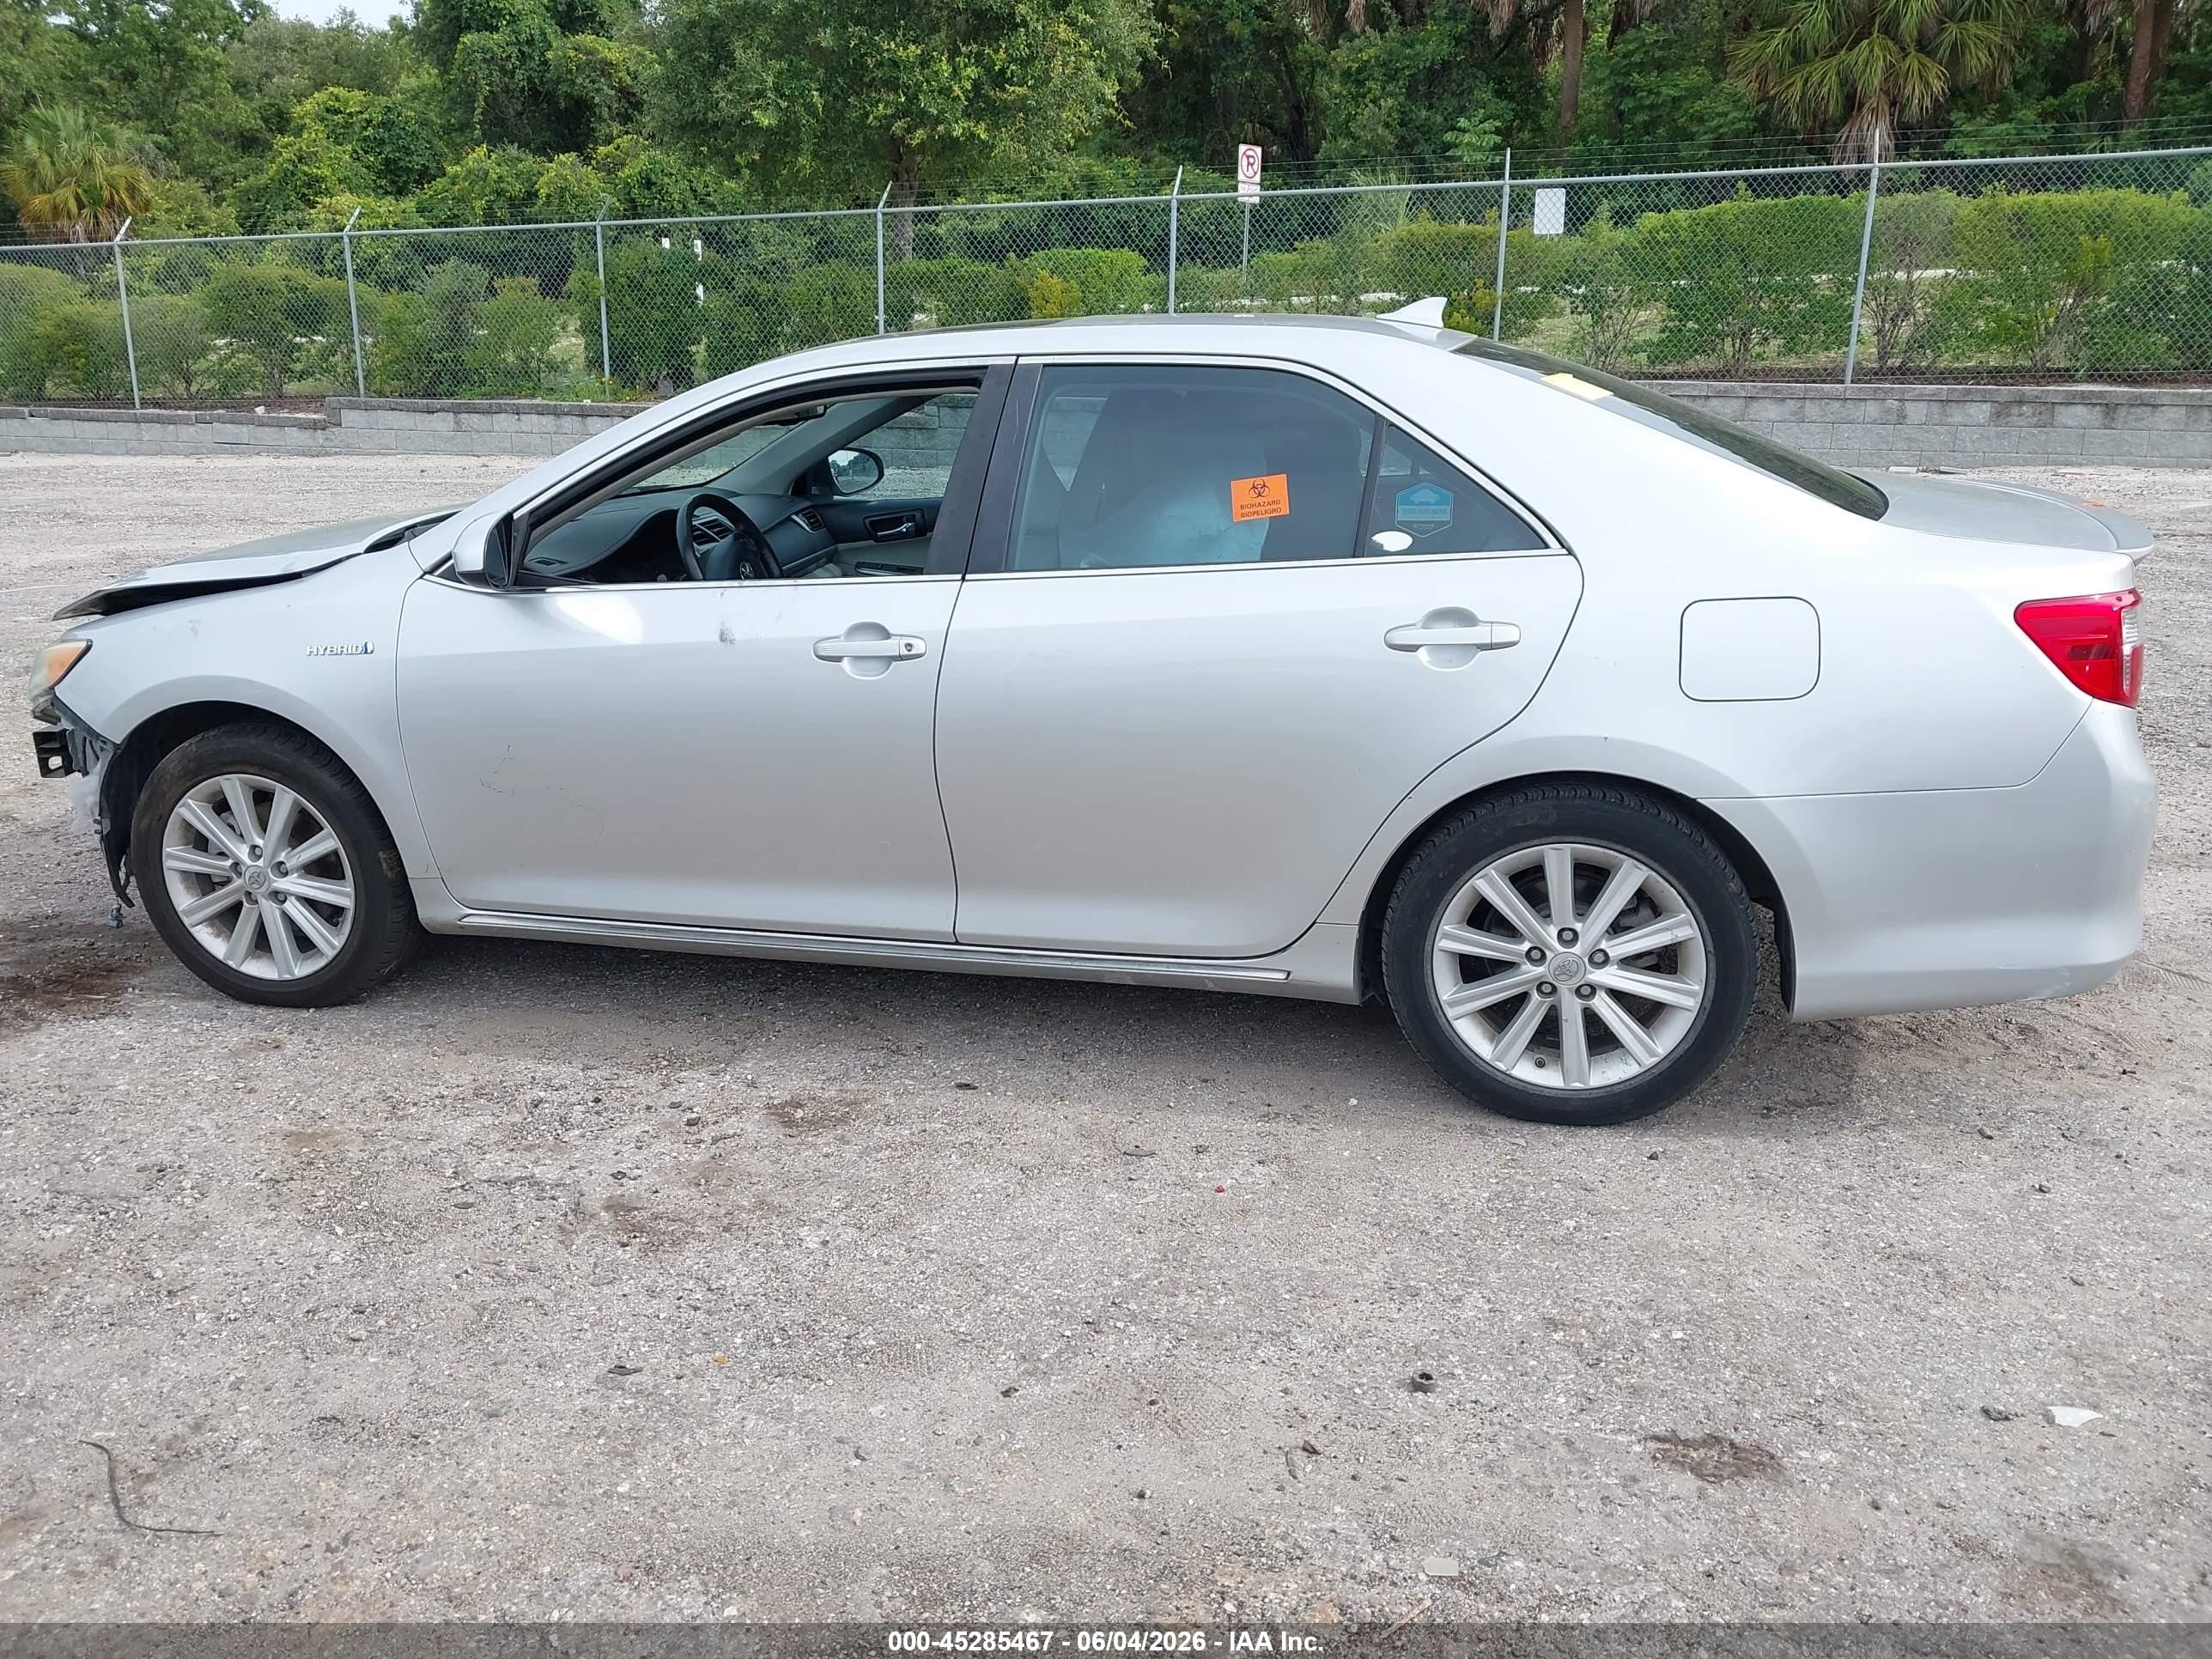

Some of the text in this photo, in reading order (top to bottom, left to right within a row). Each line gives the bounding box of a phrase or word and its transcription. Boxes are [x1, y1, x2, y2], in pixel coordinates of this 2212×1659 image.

[1240, 499, 1281, 510] BIOHAZARD
[1240, 507, 1282, 518] BIOPELIGRO
[307, 645, 362, 656] HYBRID
